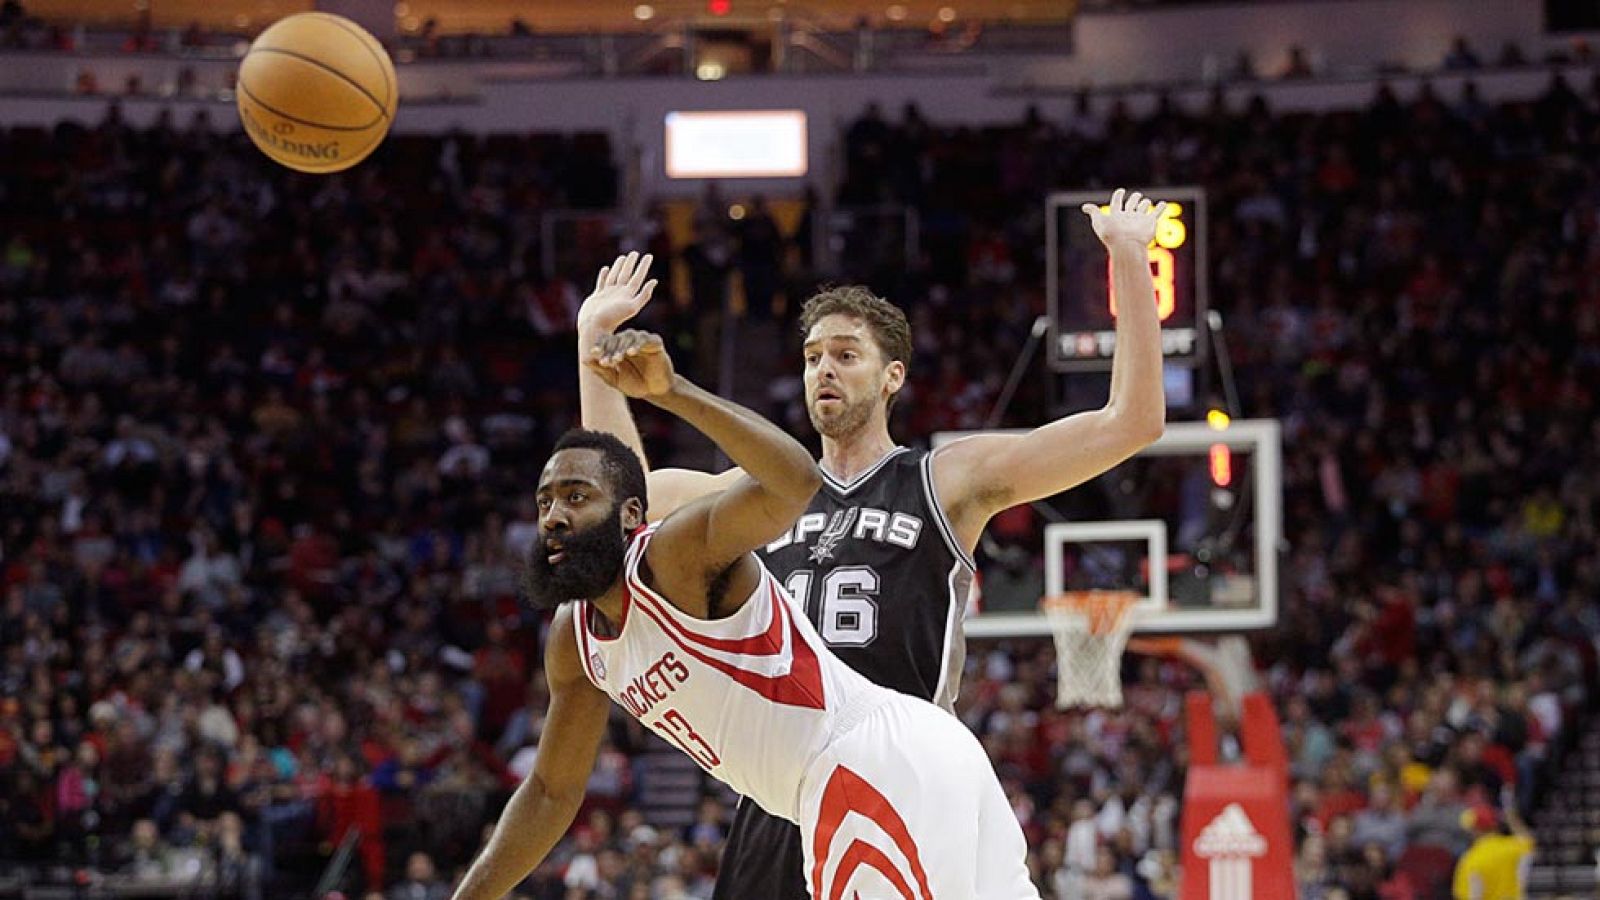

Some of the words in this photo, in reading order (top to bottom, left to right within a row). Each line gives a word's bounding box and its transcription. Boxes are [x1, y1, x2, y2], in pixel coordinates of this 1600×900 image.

[785, 565, 880, 647] 16
[620, 652, 690, 717] OCKETS
[653, 709, 721, 770] 13
